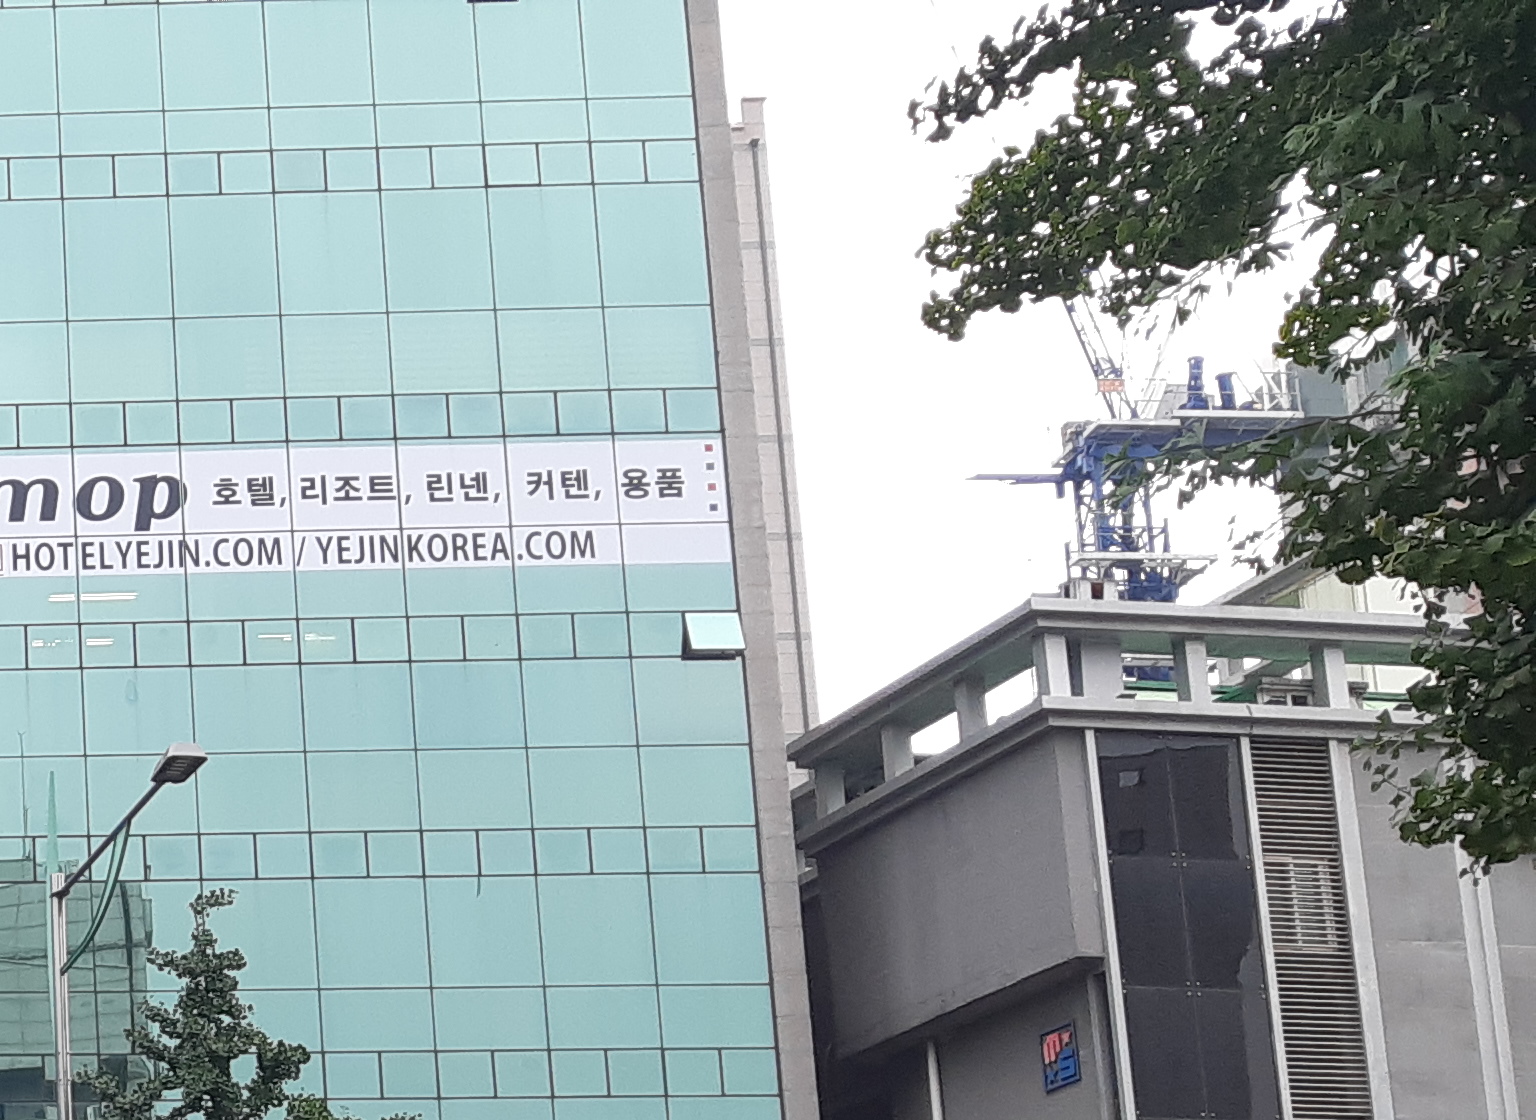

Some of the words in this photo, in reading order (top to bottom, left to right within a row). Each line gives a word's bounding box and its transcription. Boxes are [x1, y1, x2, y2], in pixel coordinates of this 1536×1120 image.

[620, 467, 686, 500] 용품
[12, 537, 284, 571] HOTELYEJIN.COM
[314, 530, 597, 566] YEJINKOREA.COM
